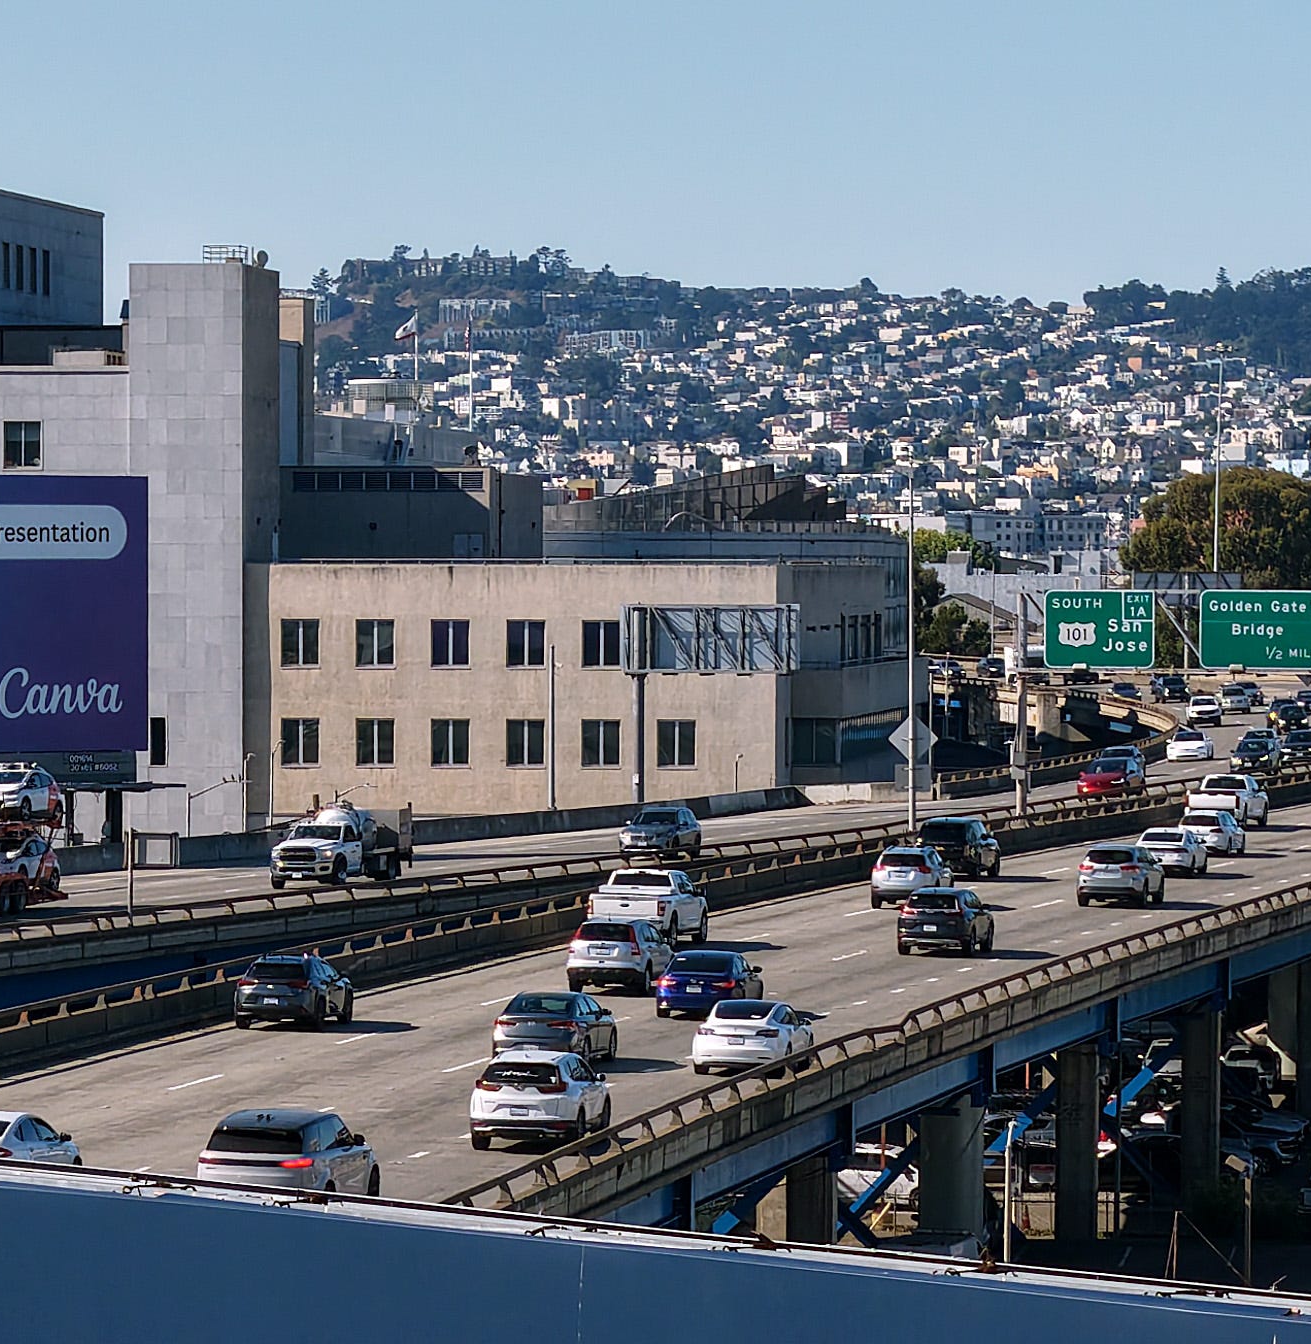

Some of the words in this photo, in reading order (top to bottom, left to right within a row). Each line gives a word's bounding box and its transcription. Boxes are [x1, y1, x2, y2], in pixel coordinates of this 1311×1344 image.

[1052, 598, 1103, 609] SOUTH
[1127, 595, 1150, 604] EXIT
[1131, 607, 1146, 617] 1A
[1209, 600, 1263, 613] Golden
[1271, 600, 1307, 614] Gate
[1107, 618, 1143, 633] San
[1232, 623, 1285, 639] Bridge
[1066, 628, 1088, 641] 101
[1102, 637, 1148, 652] Jose
[1265, 646, 1283, 660] 1/2
